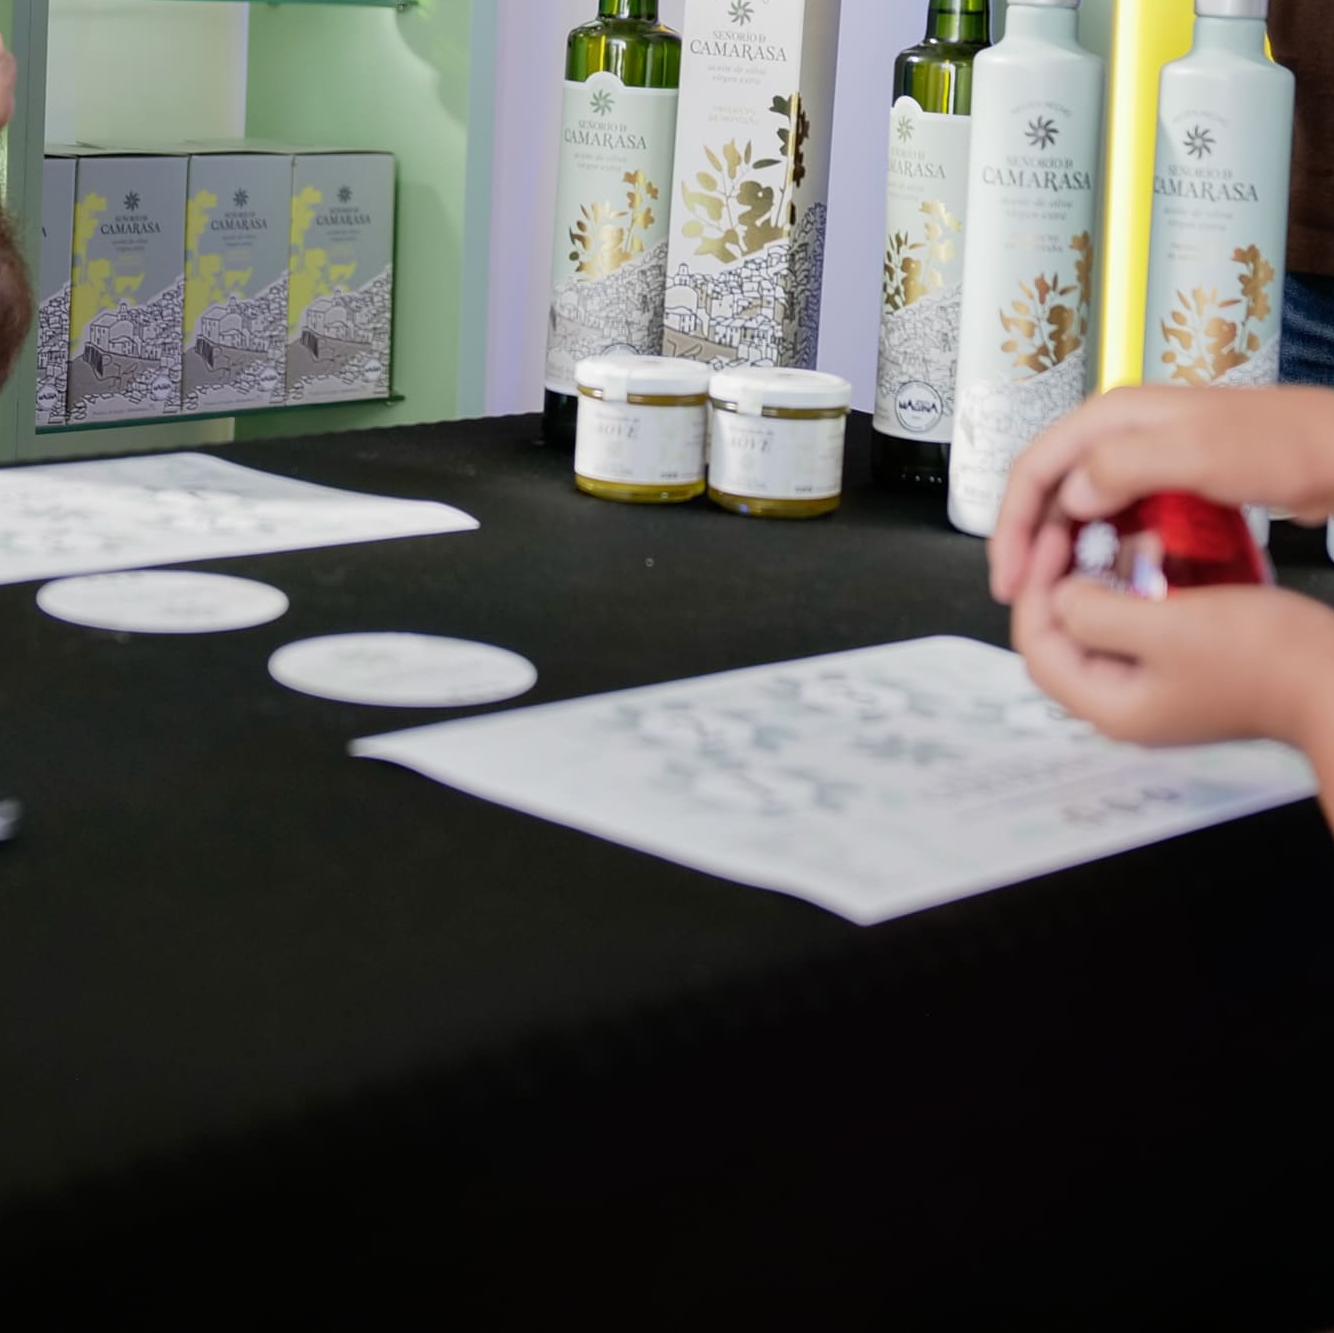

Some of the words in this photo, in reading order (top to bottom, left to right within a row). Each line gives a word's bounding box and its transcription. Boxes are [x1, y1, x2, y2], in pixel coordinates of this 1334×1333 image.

[690, 39, 788, 62] CAMARASA
[564, 129, 647, 150] CAMARASA
[982, 165, 1092, 192] CAMARASA
[100, 221, 162, 235] CAMARASA
[211, 217, 268, 231] CAMARASA
[316, 214, 372, 226] CAMARASA
